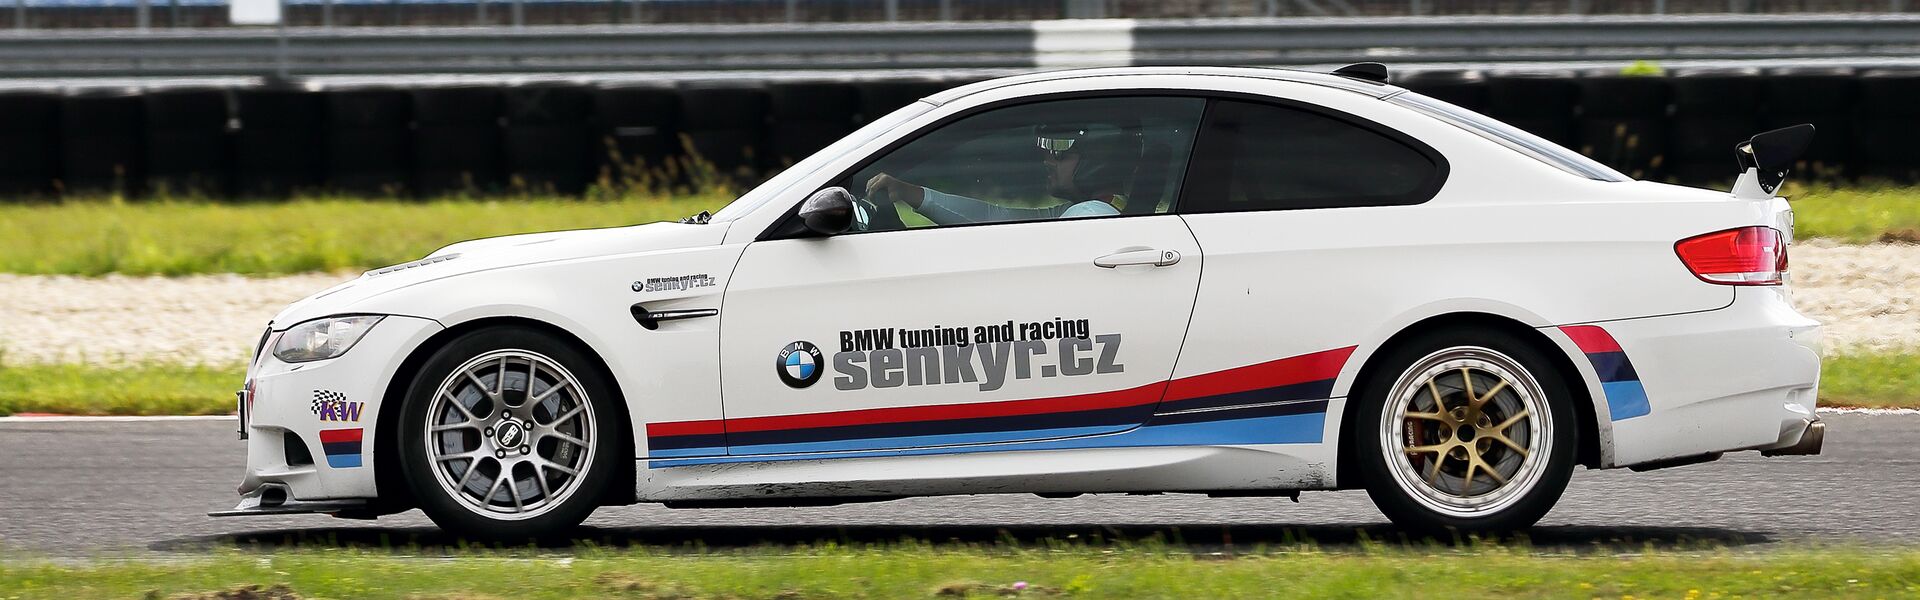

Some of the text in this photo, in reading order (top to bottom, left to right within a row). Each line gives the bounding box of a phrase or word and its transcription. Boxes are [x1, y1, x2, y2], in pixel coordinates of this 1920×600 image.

[645, 276, 716, 292] senkyr.cz
[839, 317, 1090, 353] BMW tuning and racing
[780, 342, 820, 359] BMW
[832, 333, 1124, 391] senkyr.cz
[320, 400, 364, 422] KW
[501, 425, 518, 445] BBS
